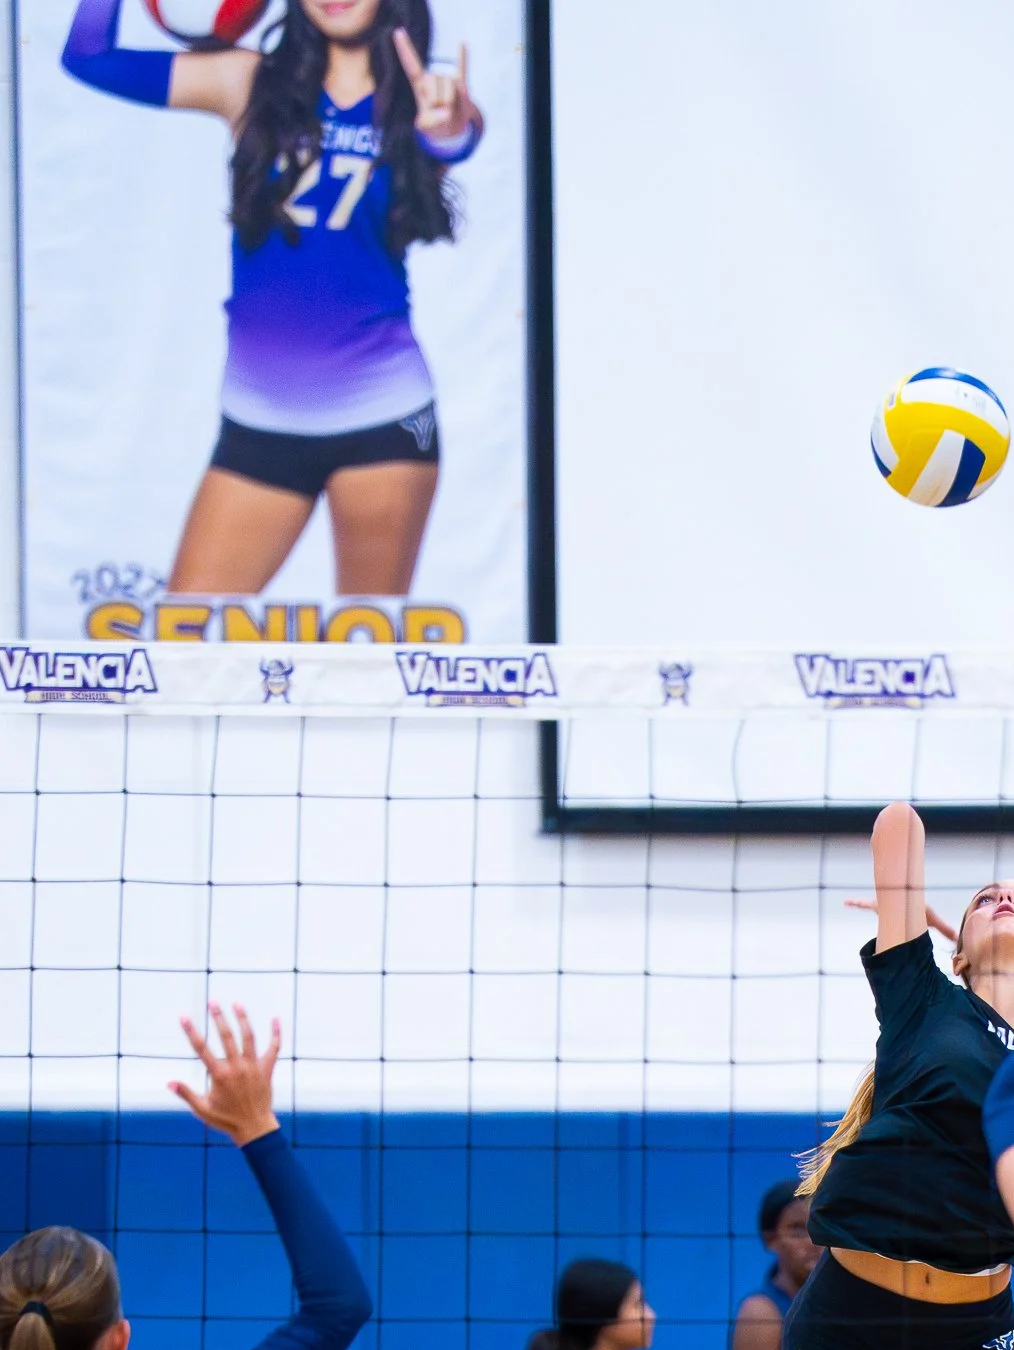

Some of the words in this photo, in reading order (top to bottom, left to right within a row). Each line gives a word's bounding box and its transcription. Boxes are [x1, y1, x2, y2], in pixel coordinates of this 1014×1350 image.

[274, 151, 374, 230] 27
[0, 646, 158, 693] VALENCIA
[395, 651, 558, 697] VALENCIA
[794, 653, 956, 698] VALENCIA
